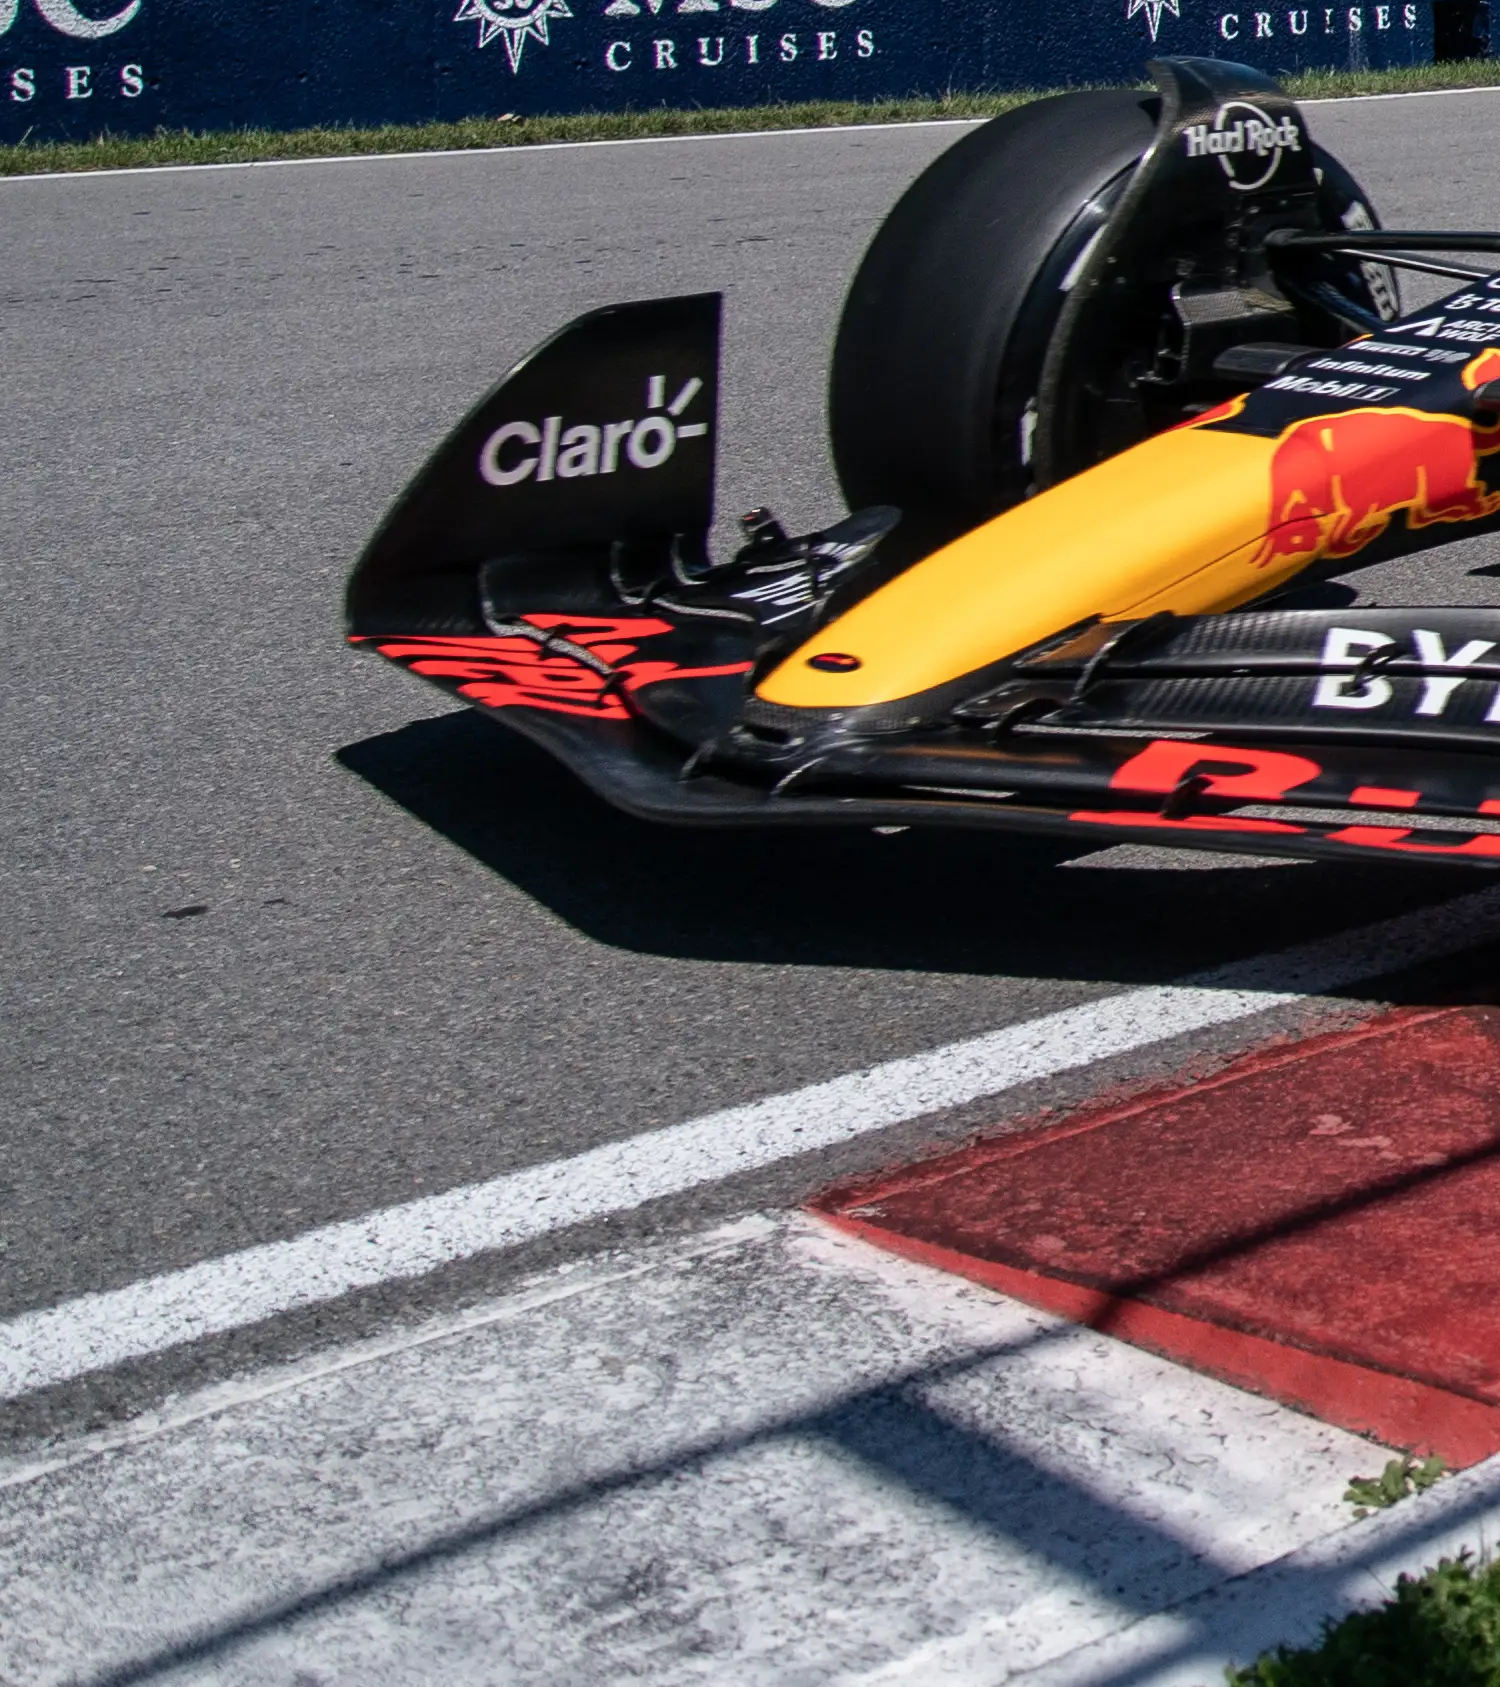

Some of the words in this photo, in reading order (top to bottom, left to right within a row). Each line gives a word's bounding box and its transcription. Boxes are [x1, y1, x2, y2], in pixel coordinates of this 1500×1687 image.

[1220, 3, 1417, 41] CRUISES
[605, 29, 875, 72] CRUISES
[1184, 119, 1246, 157] Hard
[1244, 116, 1302, 157] Rock
[1263, 375, 1368, 398] Mobil
[479, 416, 676, 486] Claro
